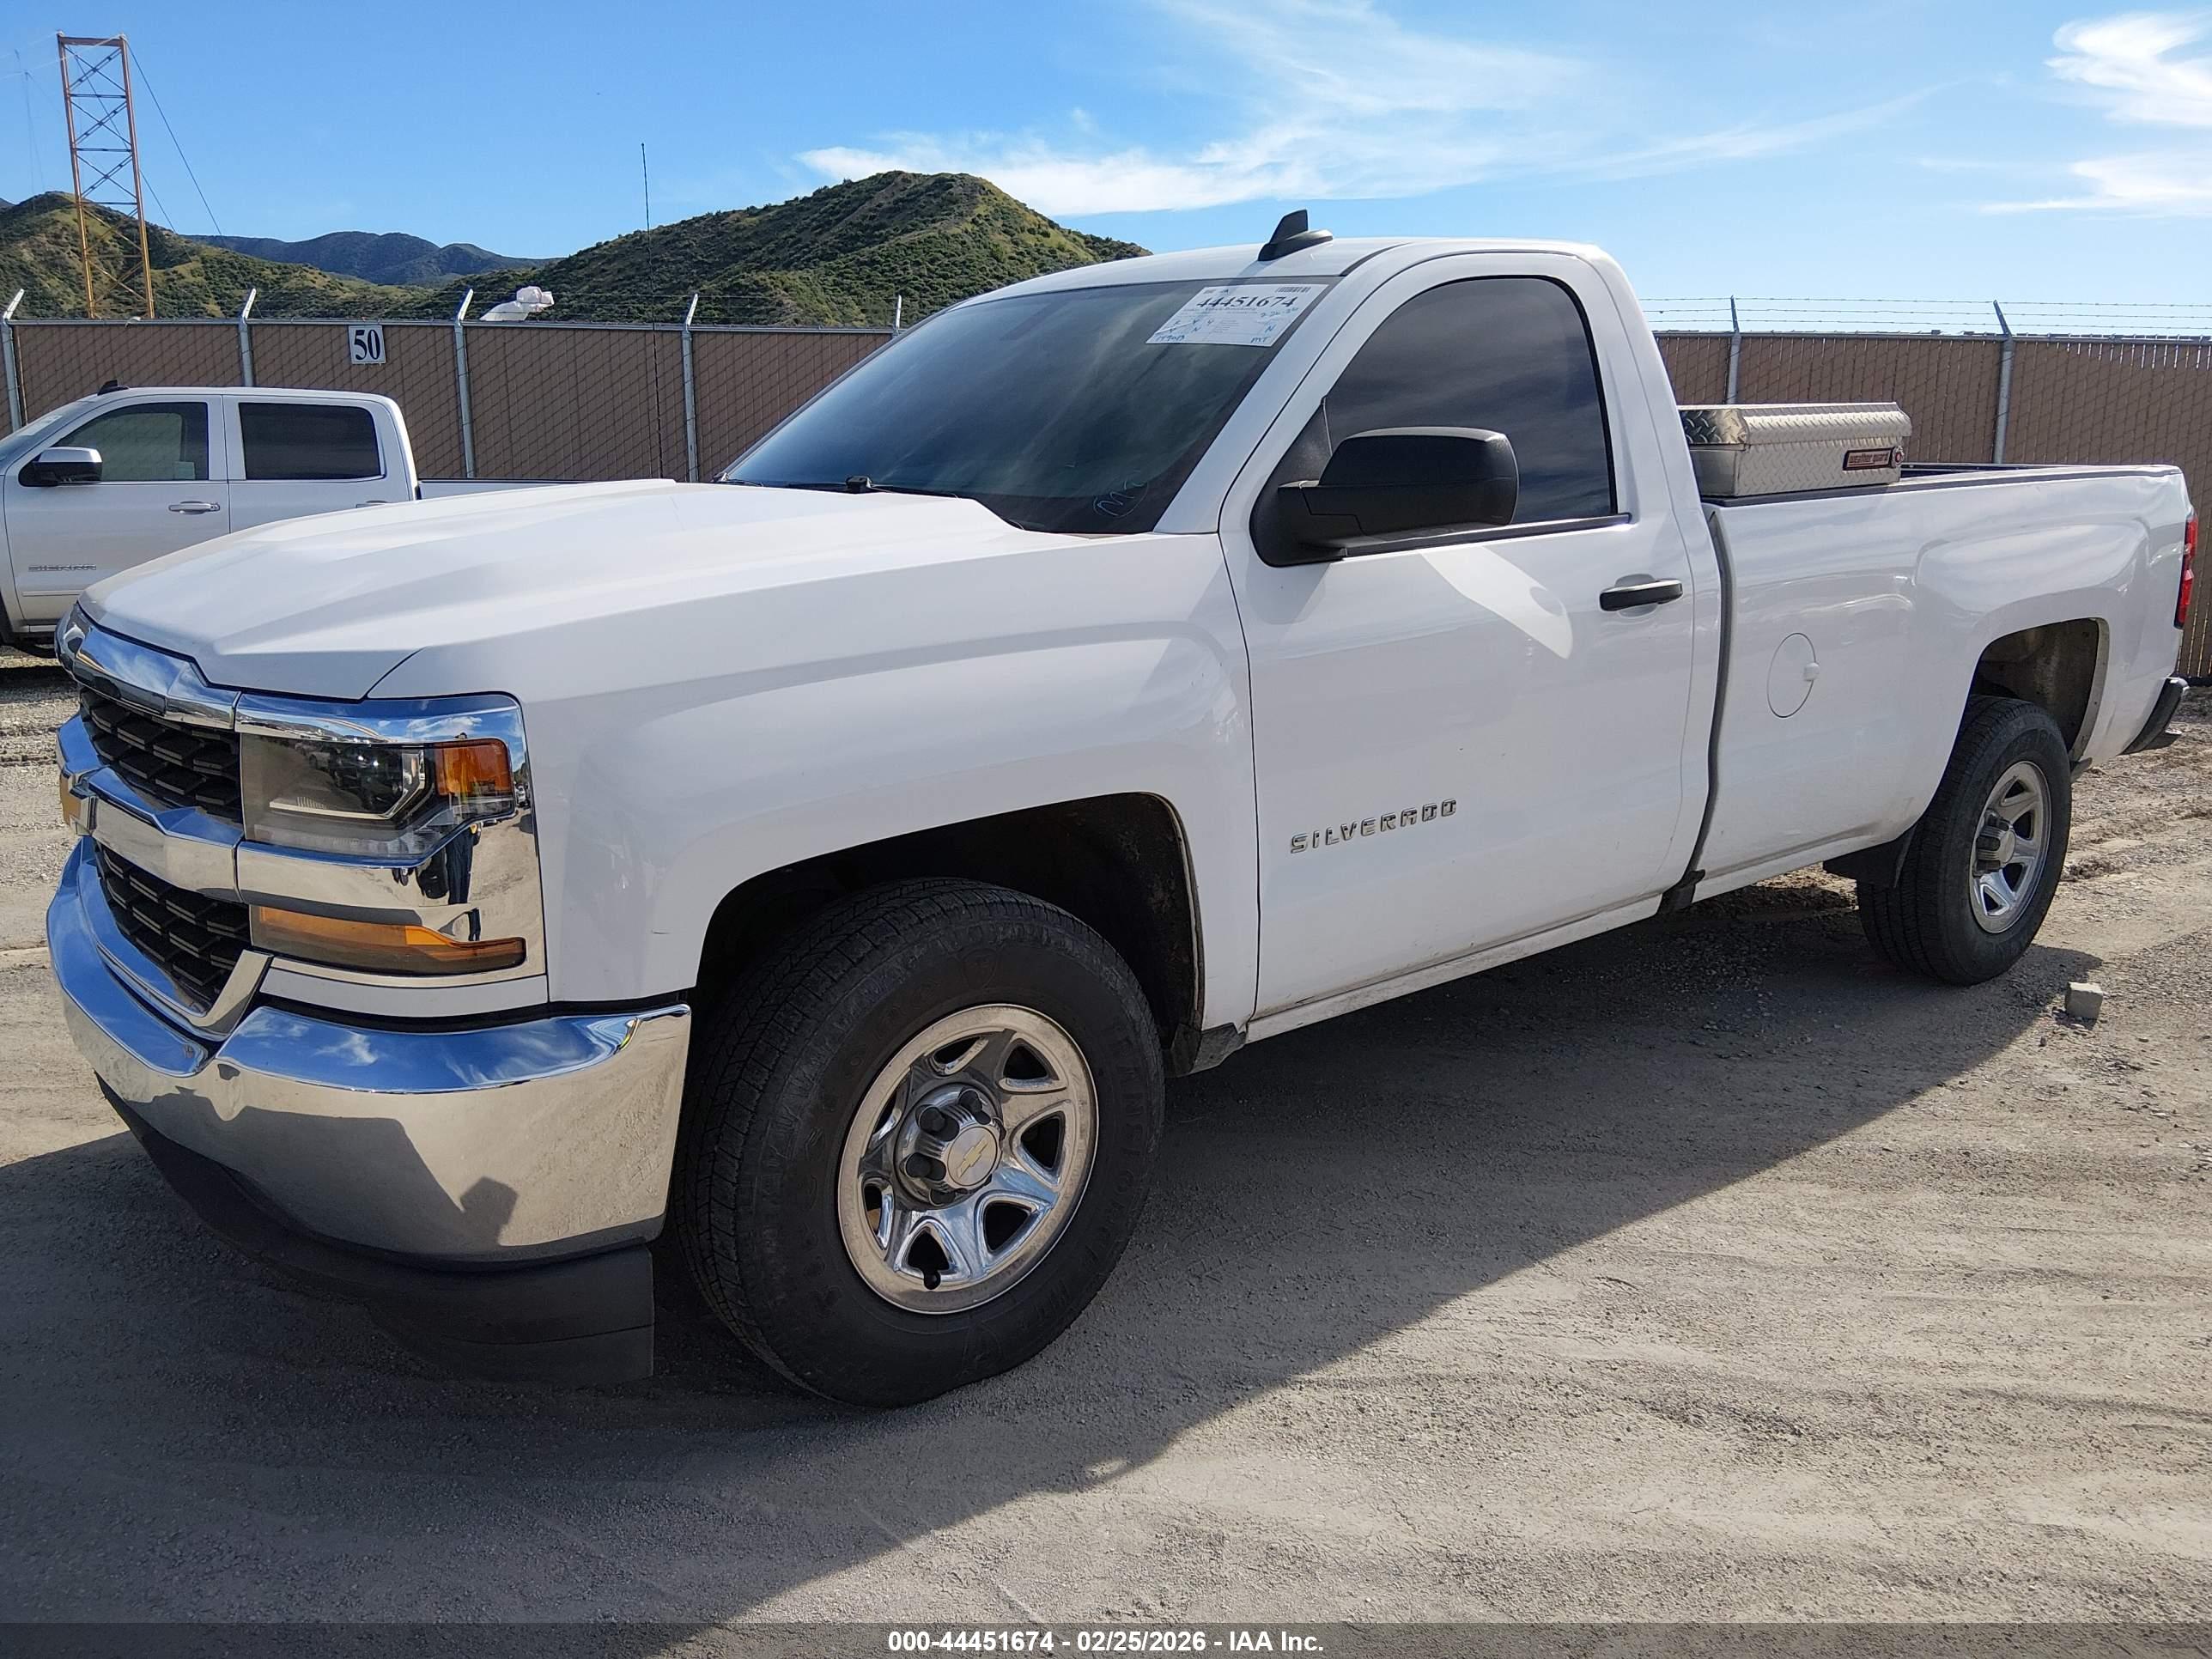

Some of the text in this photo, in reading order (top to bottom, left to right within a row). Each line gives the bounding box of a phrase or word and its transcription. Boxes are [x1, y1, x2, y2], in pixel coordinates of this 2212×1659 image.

[1197, 295, 1297, 308] 44451674
[354, 329, 380, 360] 50
[1290, 799, 1457, 854] SILVERADO
